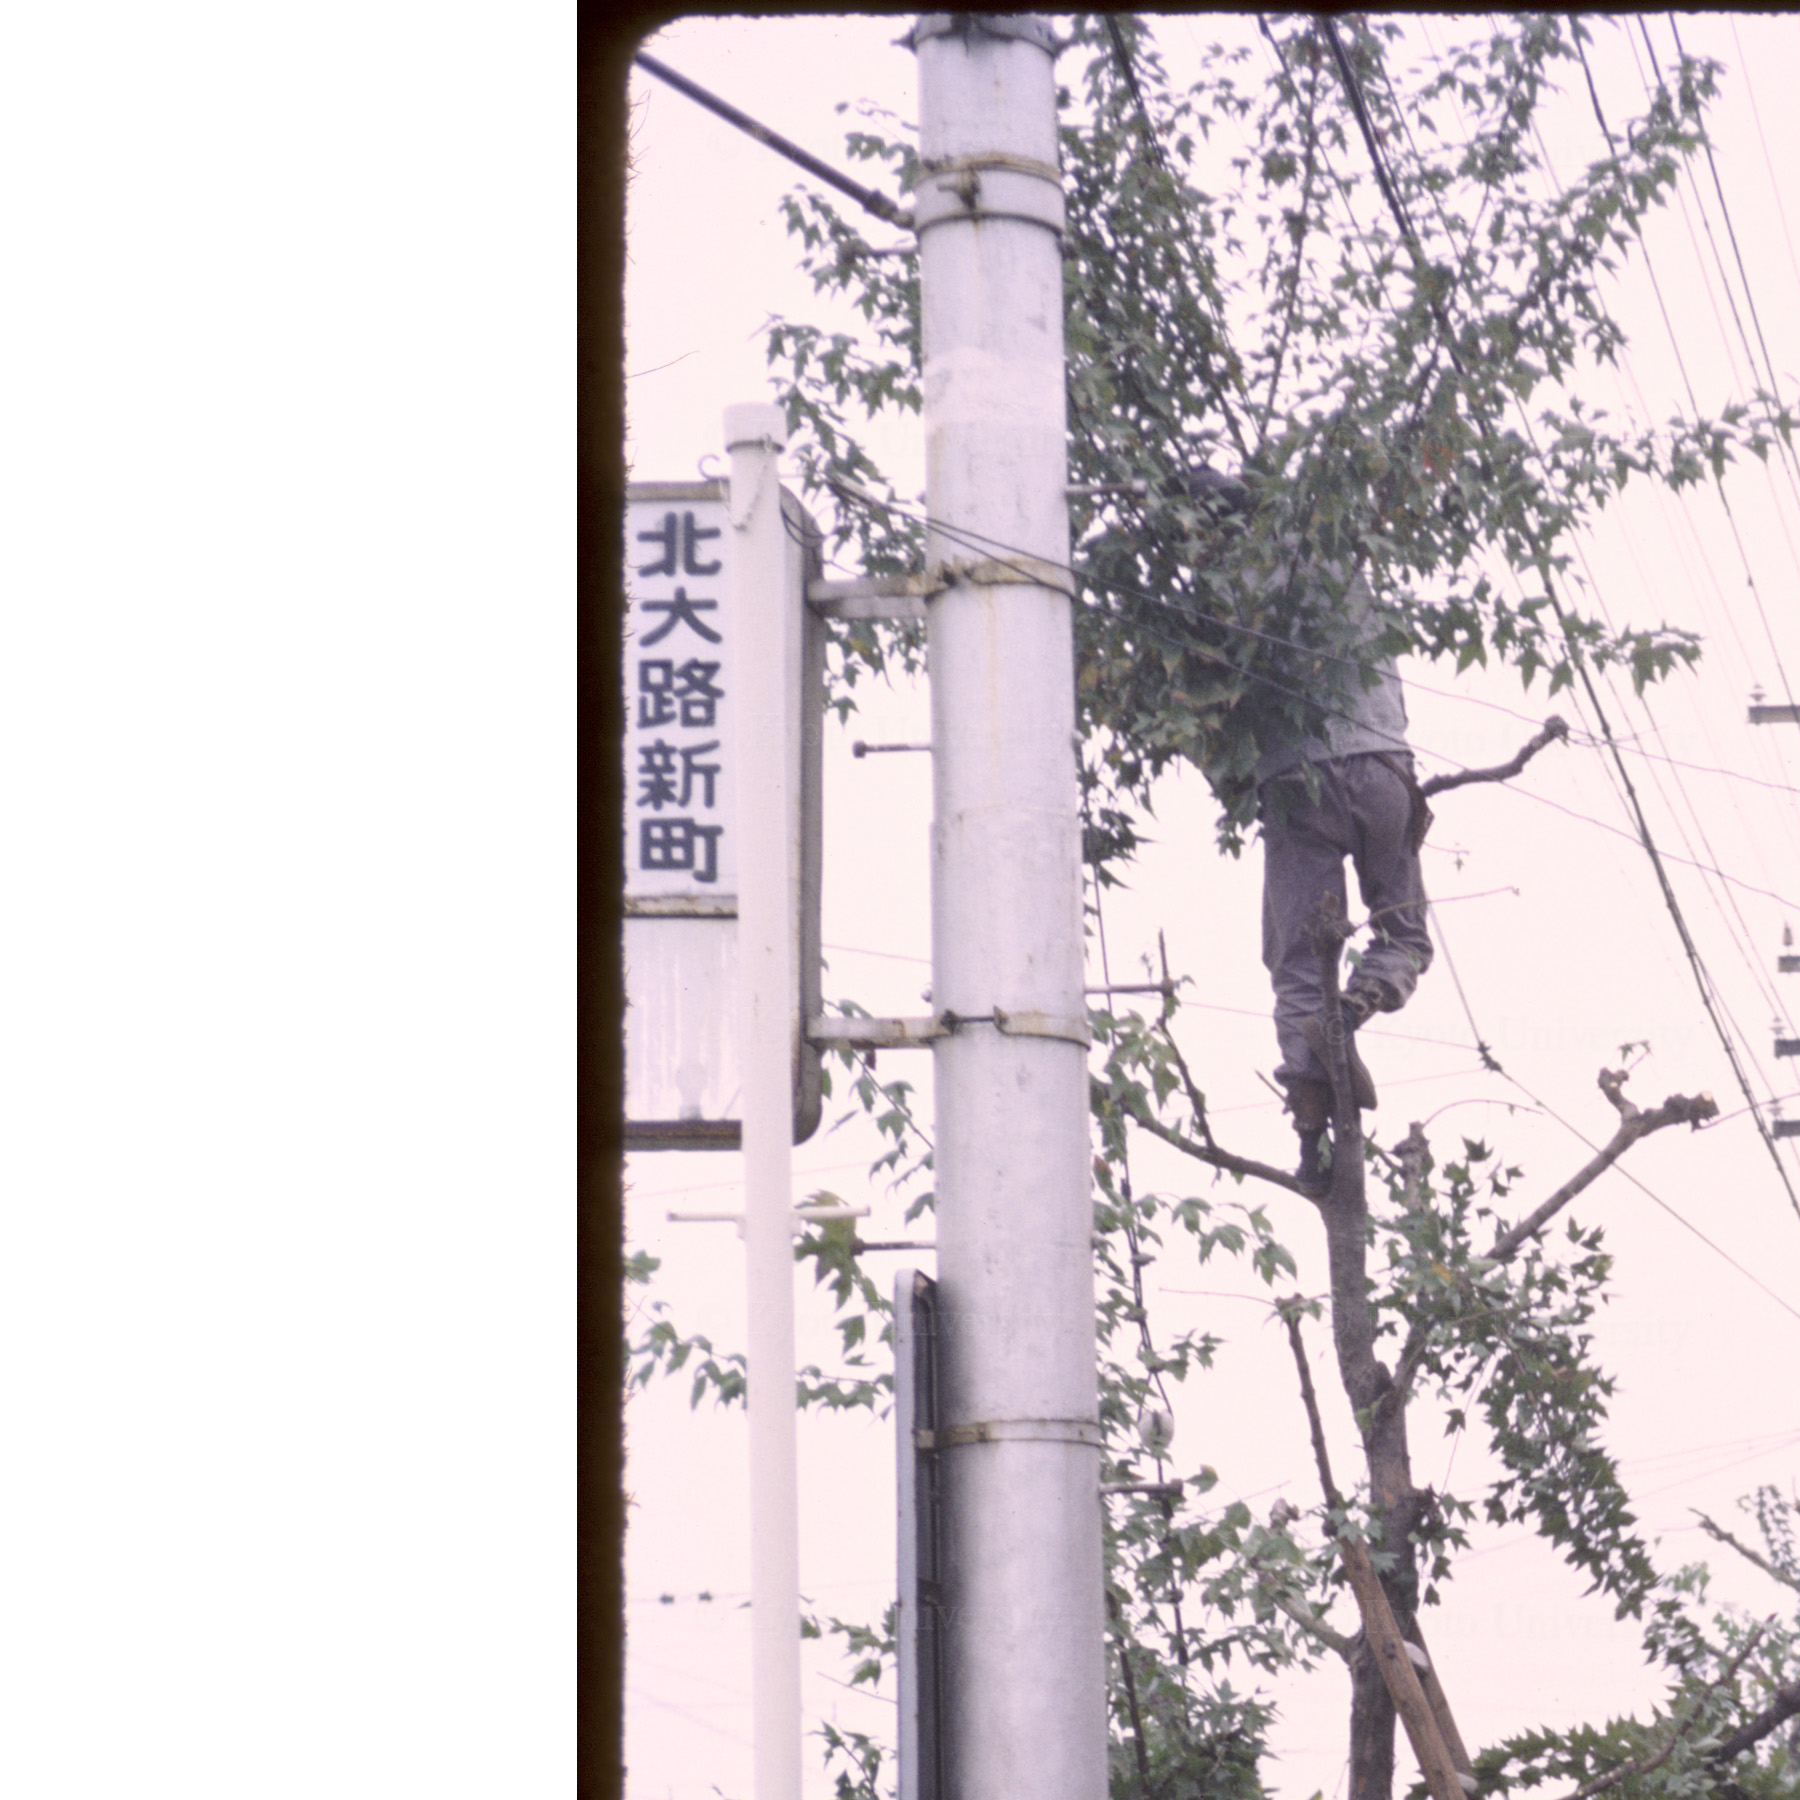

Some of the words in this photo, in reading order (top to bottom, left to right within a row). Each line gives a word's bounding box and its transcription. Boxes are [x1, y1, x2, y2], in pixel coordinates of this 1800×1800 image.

[637, 510, 724, 884] 北大路新町
